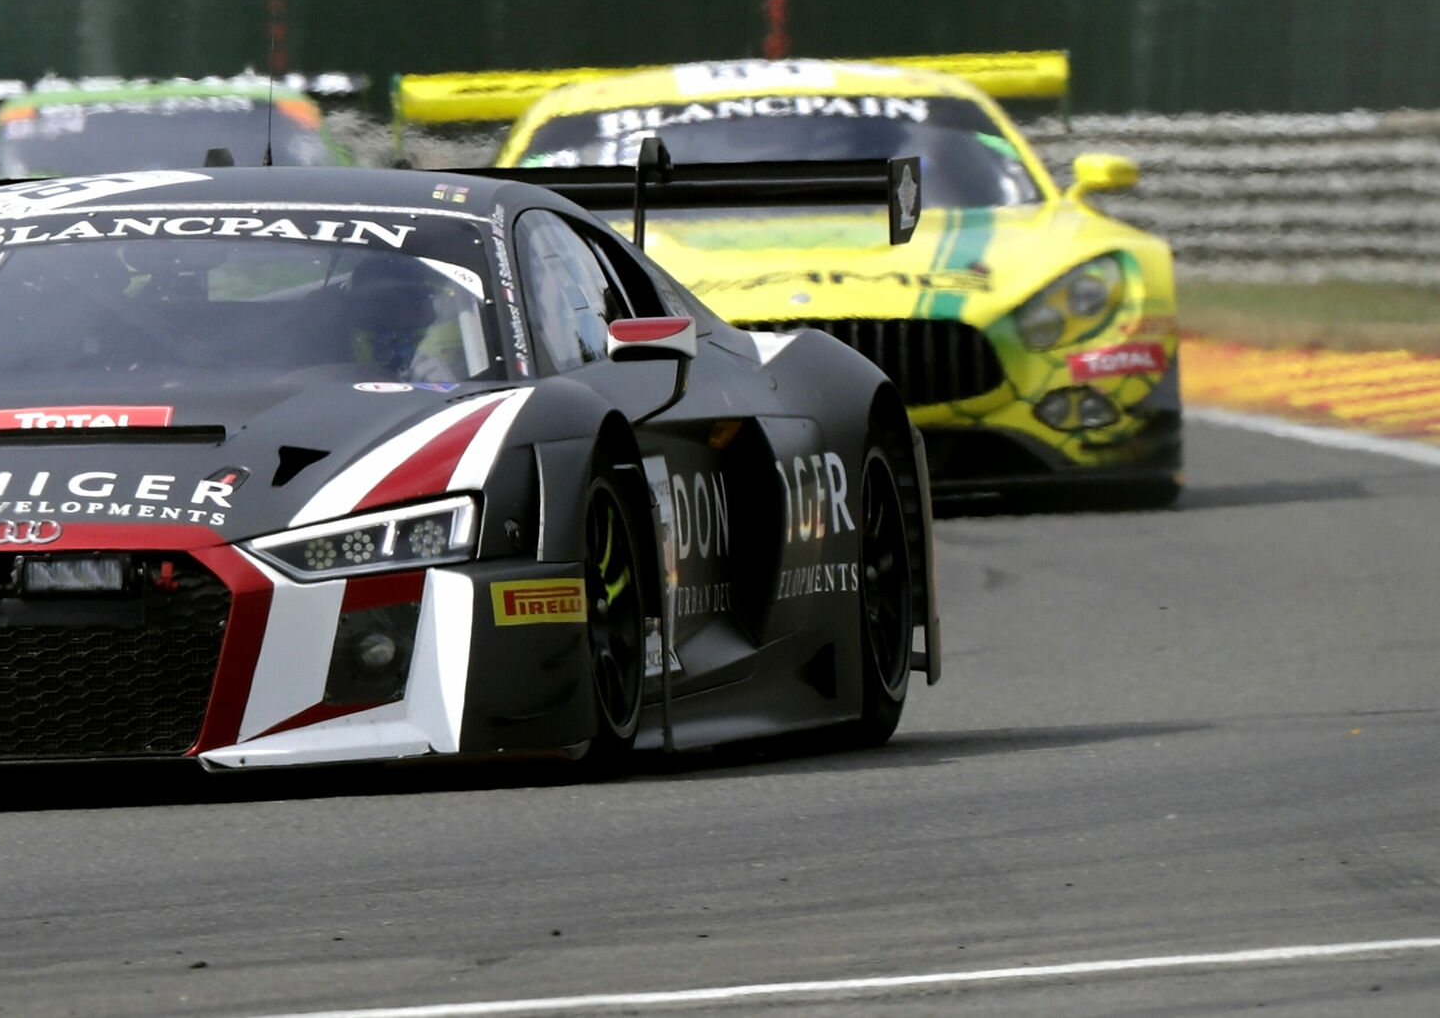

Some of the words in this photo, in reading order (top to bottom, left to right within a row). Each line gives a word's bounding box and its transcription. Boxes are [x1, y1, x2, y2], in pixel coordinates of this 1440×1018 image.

[597, 96, 929, 139] BLANCPAIN
[1081, 351, 1155, 373] TOTAL
[503, 586, 582, 616] PIRELLI
